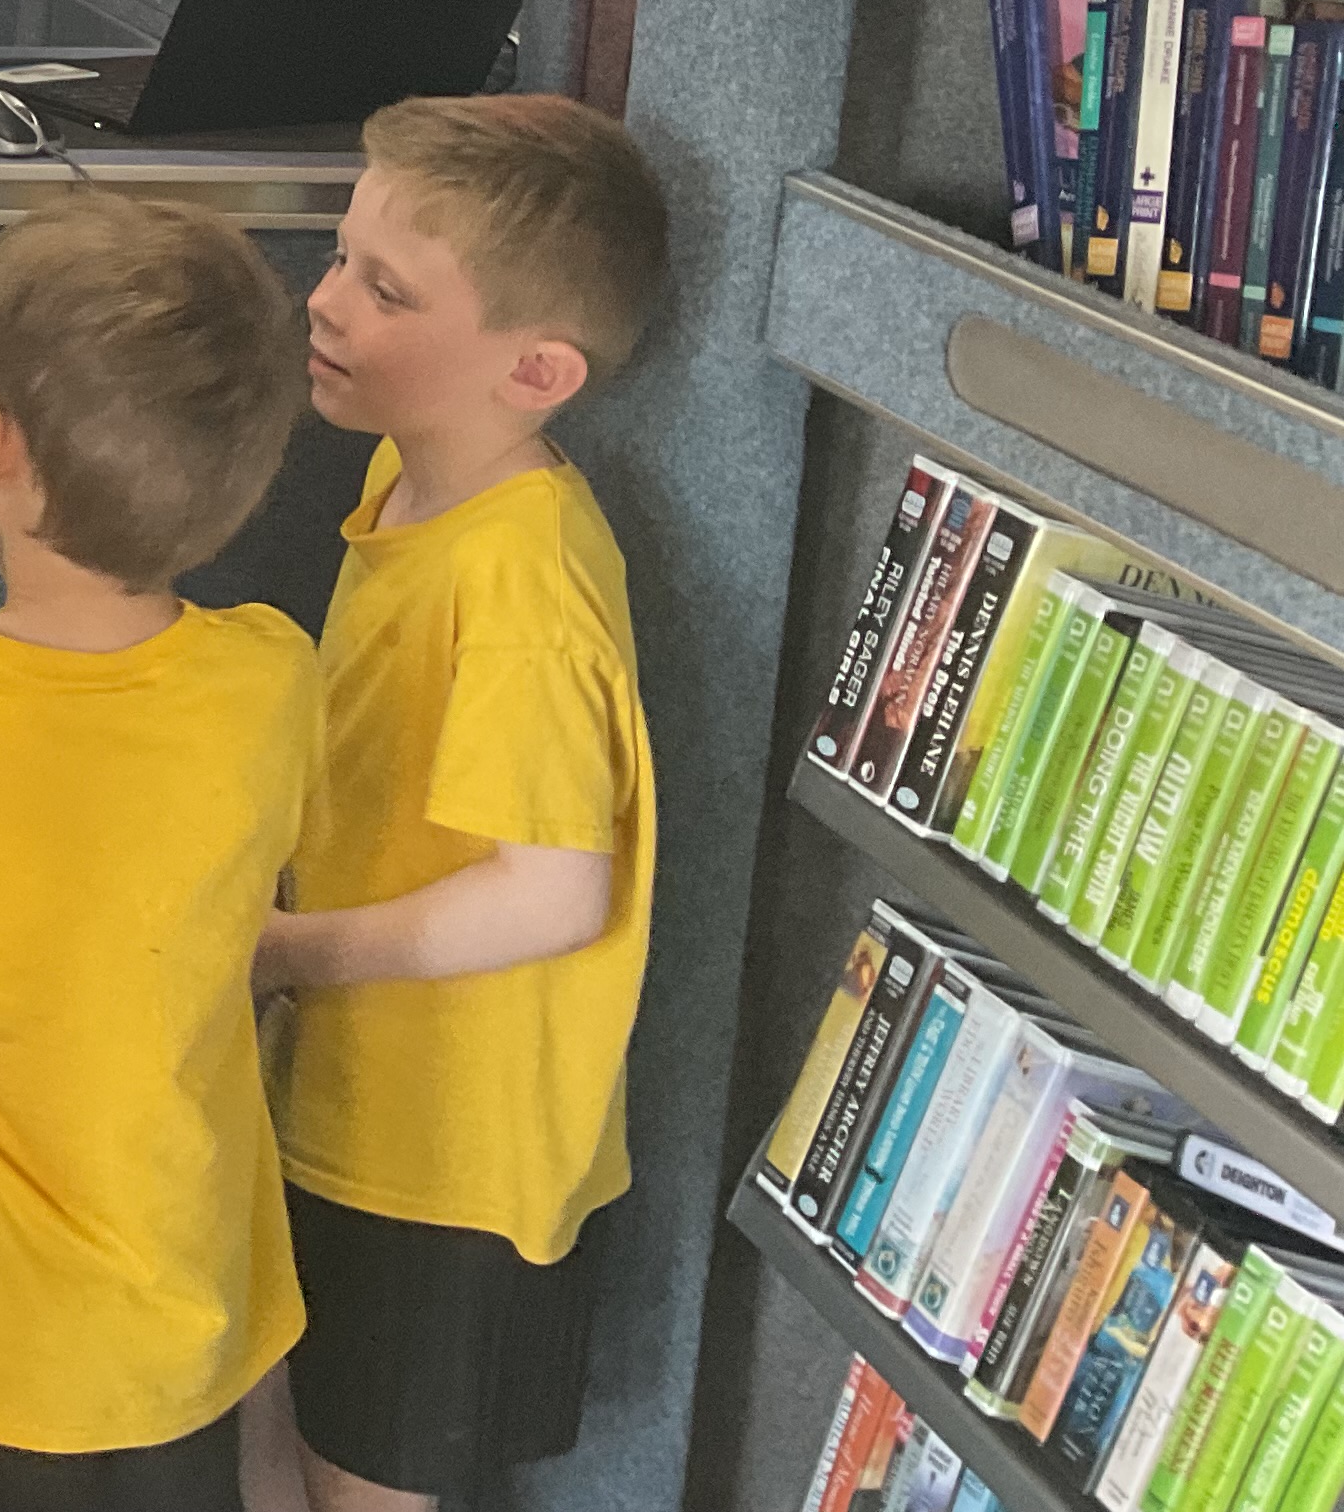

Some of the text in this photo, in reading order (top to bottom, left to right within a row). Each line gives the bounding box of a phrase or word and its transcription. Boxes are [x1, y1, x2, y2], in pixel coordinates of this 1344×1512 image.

[828, 546, 891, 706] FINAL GIRLS
[842, 560, 904, 708] RILEY SAGER
[892, 555, 942, 672] Twisted Minds
[895, 562, 953, 705] HILARY NORMAN
[920, 591, 999, 777] DENNIS LEHANE
[922, 629, 965, 718] The Drop
[1064, 706, 1134, 863] DOING TIME
[1106, 789, 1141, 850] NIGHT
[1127, 751, 1156, 785] THE
[1256, 868, 1318, 1005] damascus
[855, 1012, 892, 1094] JEFFREY
[818, 1092, 861, 1185] ARCHER
[1220, 1163, 1288, 1206] DEIGHTON
